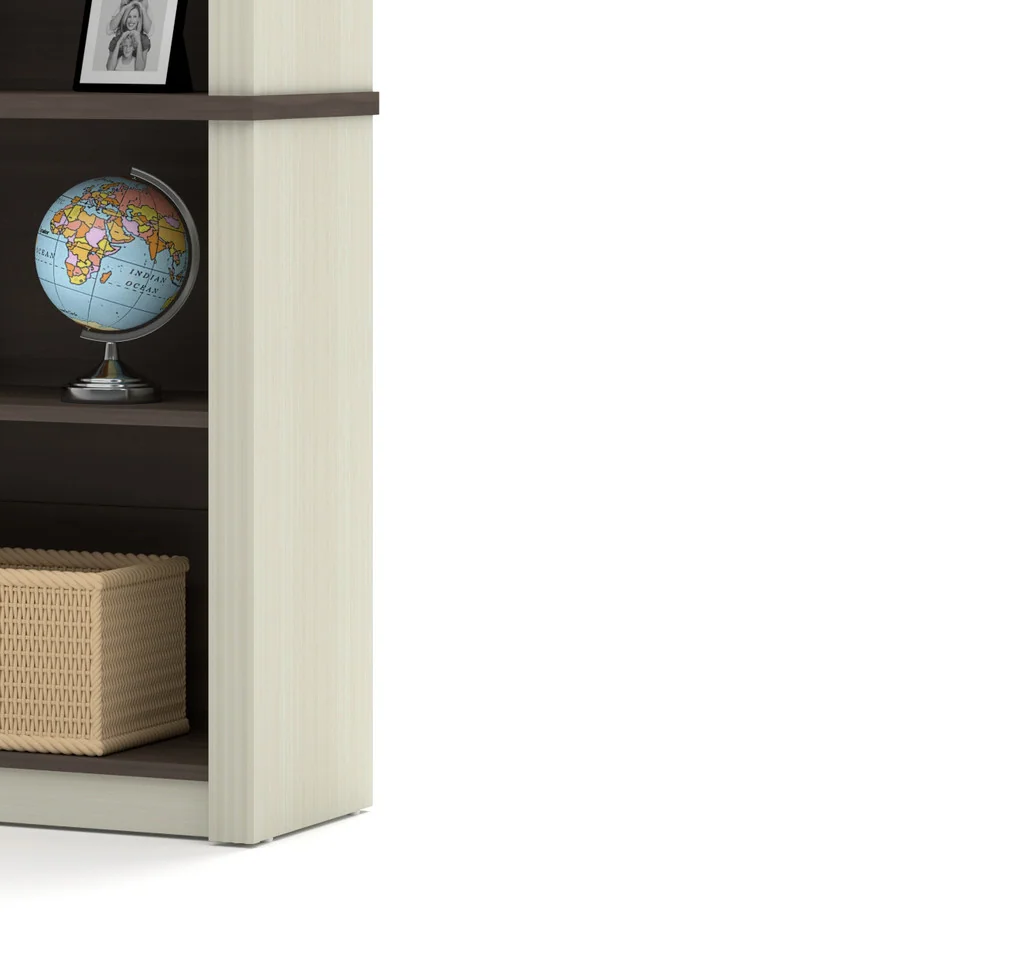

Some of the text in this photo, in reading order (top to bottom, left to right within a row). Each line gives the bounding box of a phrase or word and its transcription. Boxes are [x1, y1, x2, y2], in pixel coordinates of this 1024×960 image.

[36, 247, 56, 259] CEAN
[129, 268, 167, 284] INDIAN
[125, 280, 159, 294] OCEAN
